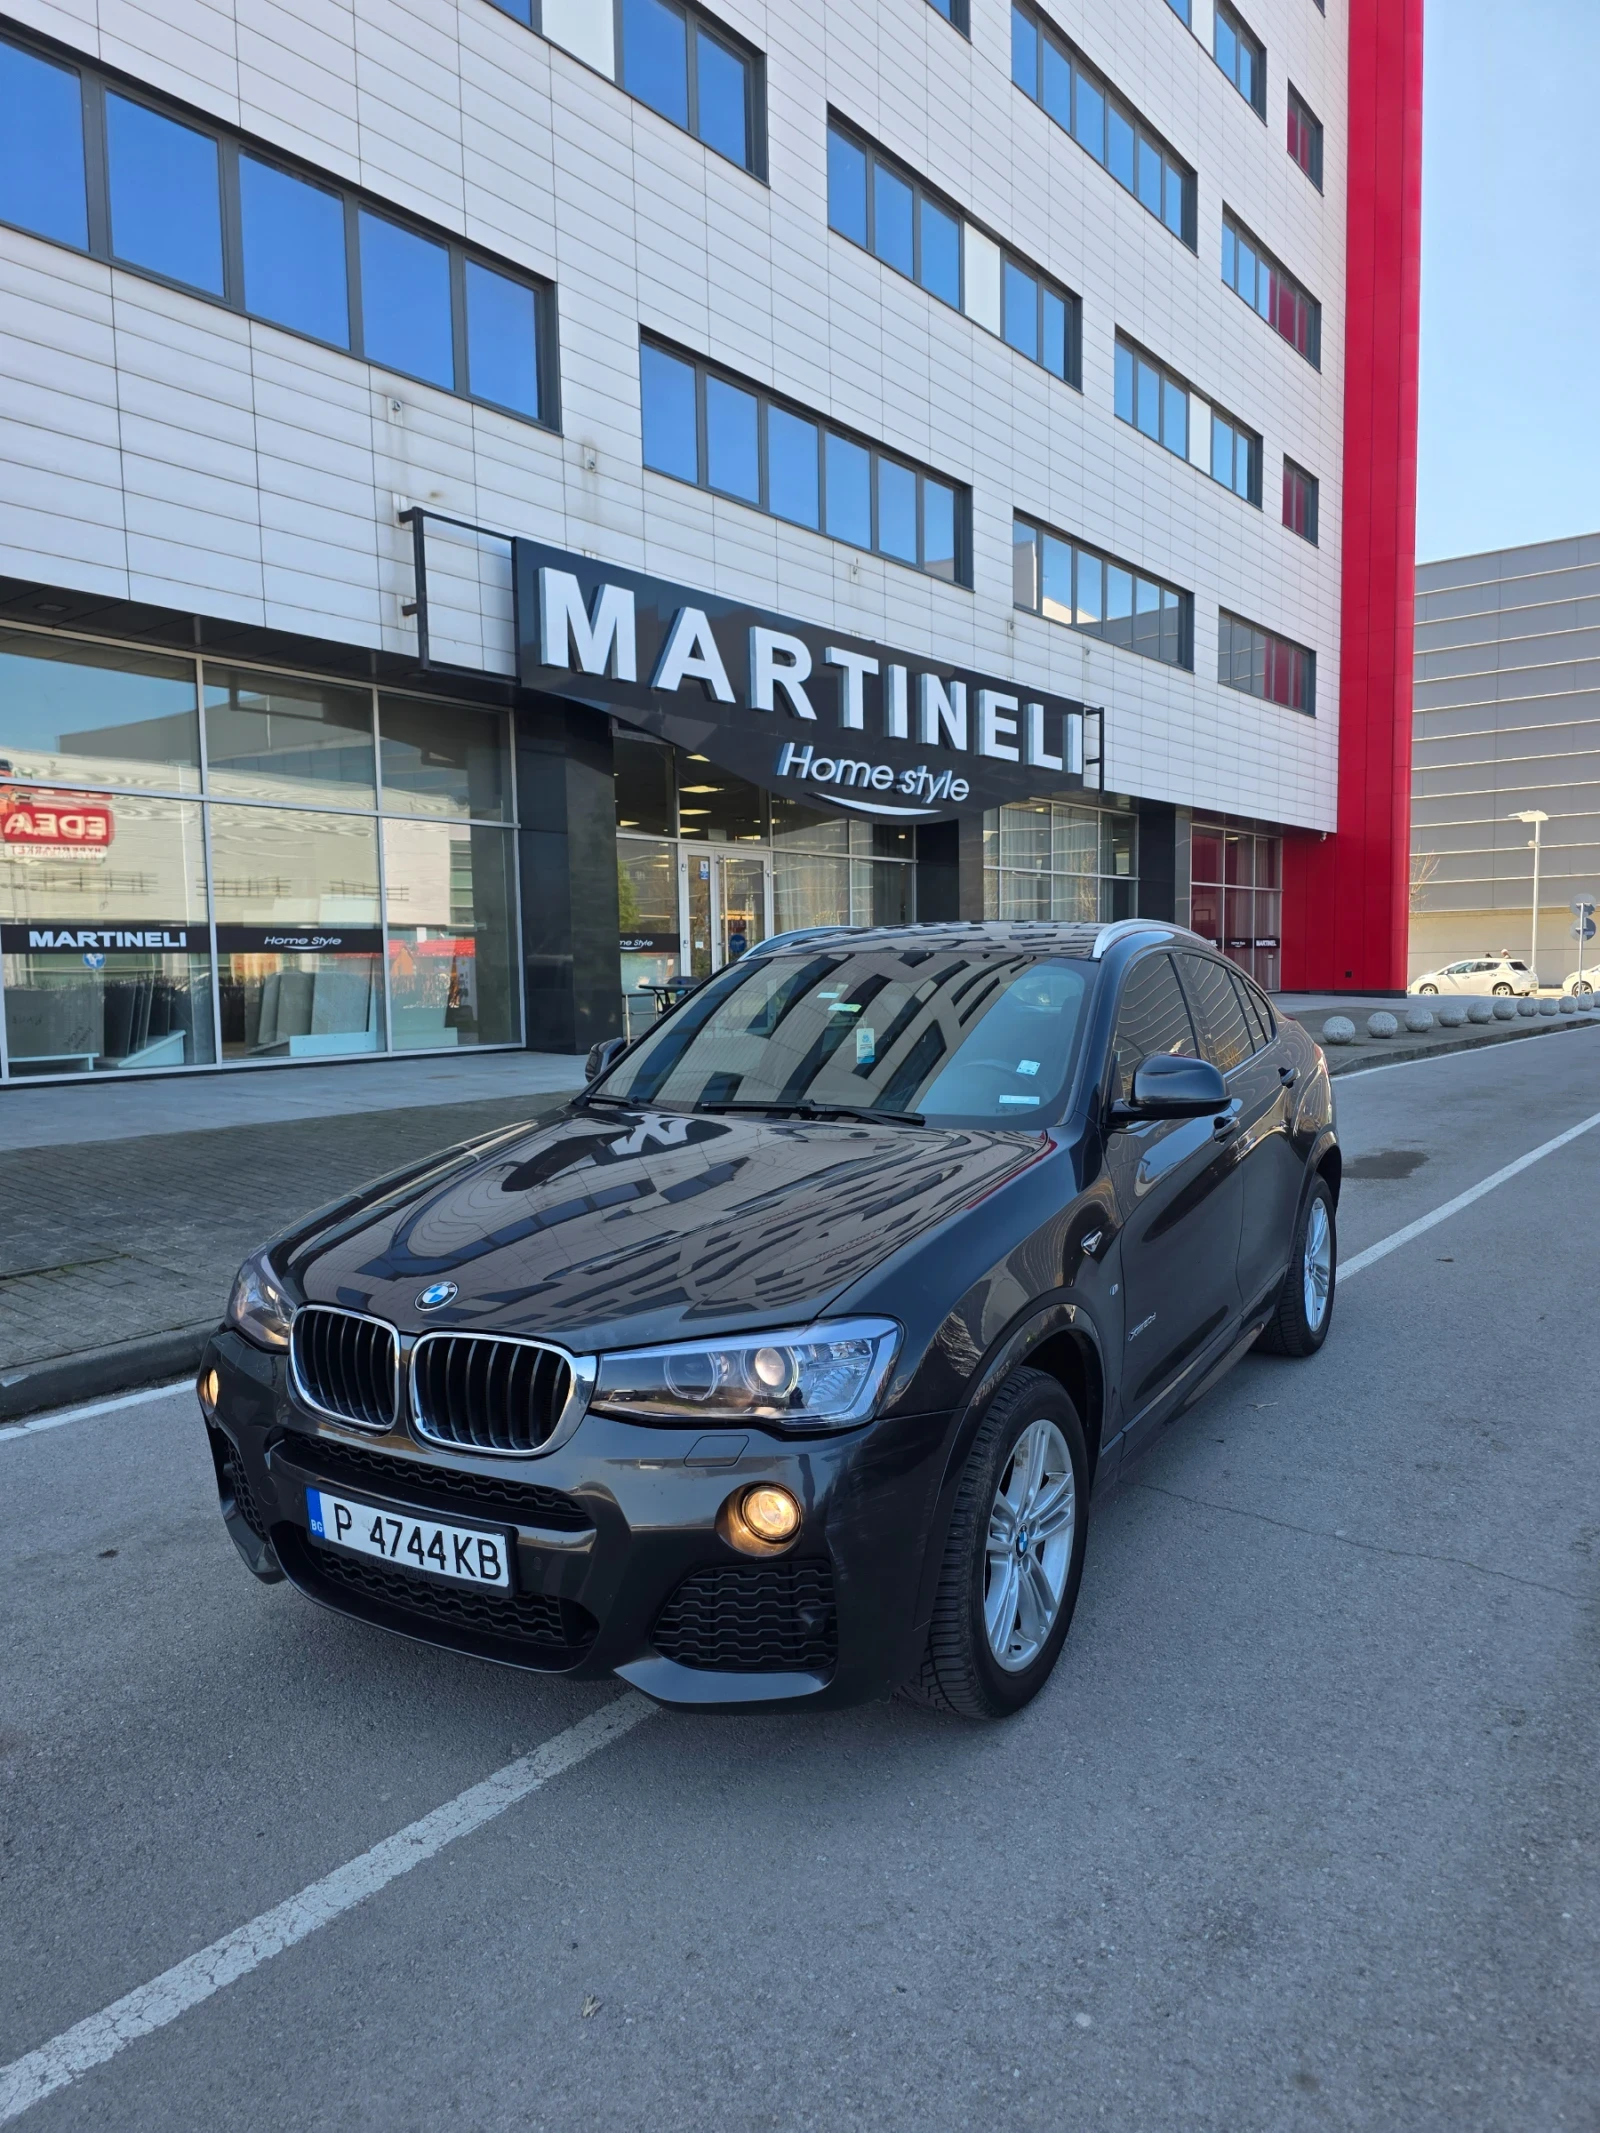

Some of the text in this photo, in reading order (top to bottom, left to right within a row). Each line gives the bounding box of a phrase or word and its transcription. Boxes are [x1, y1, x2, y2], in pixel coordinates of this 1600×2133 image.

[539, 566, 1082, 774] MARTINELI
[777, 742, 971, 805] Home style
[28, 930, 187, 948] MARTINELI
[264, 935, 342, 948] Home Style
[633, 938, 654, 947] Style
[311, 1519, 324, 1533] BG
[334, 1502, 352, 1541] P
[369, 1515, 502, 1581] 4744KB
